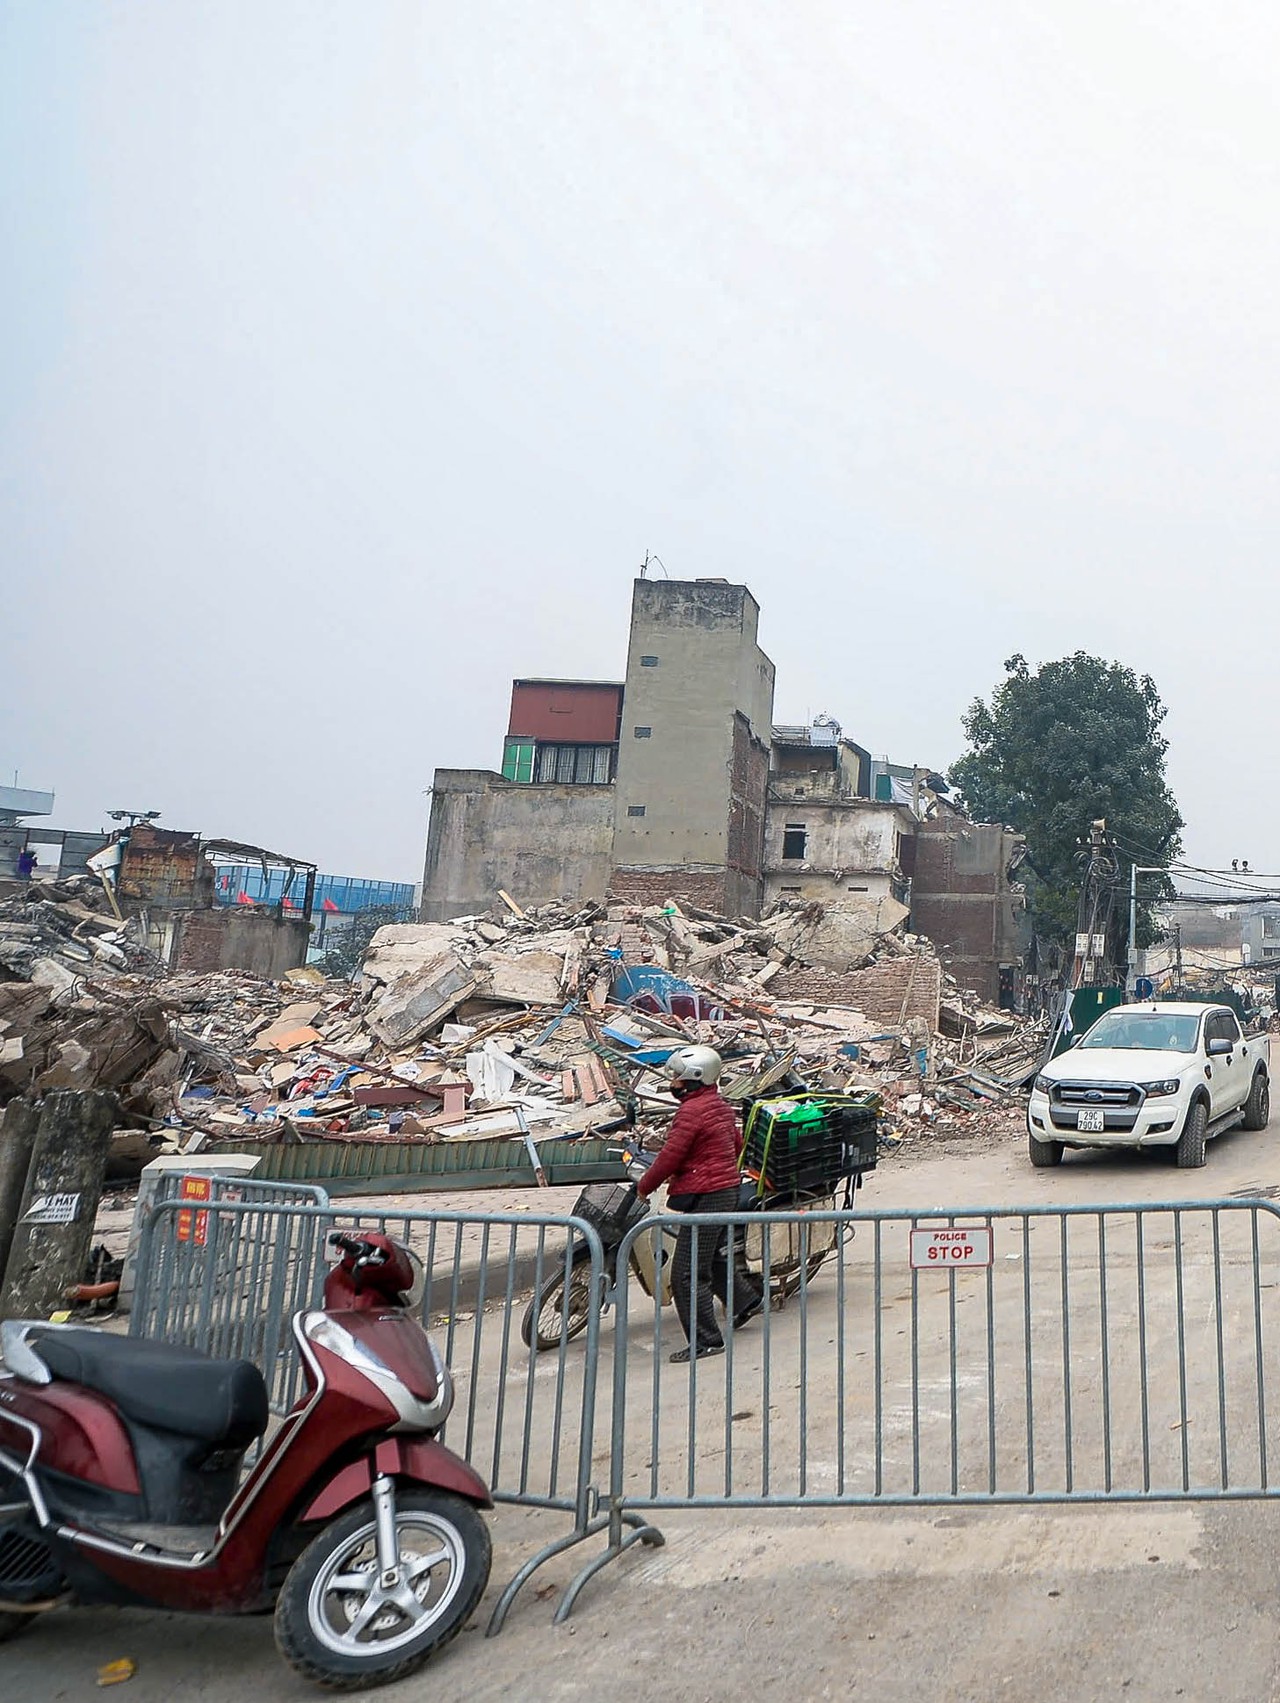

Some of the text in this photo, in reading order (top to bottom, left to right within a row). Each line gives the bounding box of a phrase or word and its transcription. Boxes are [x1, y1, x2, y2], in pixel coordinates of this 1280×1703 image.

[1084, 1111, 1098, 1121] 29C
[934, 1233, 967, 1241] POLICE
[928, 1246, 973, 1260] STOP
